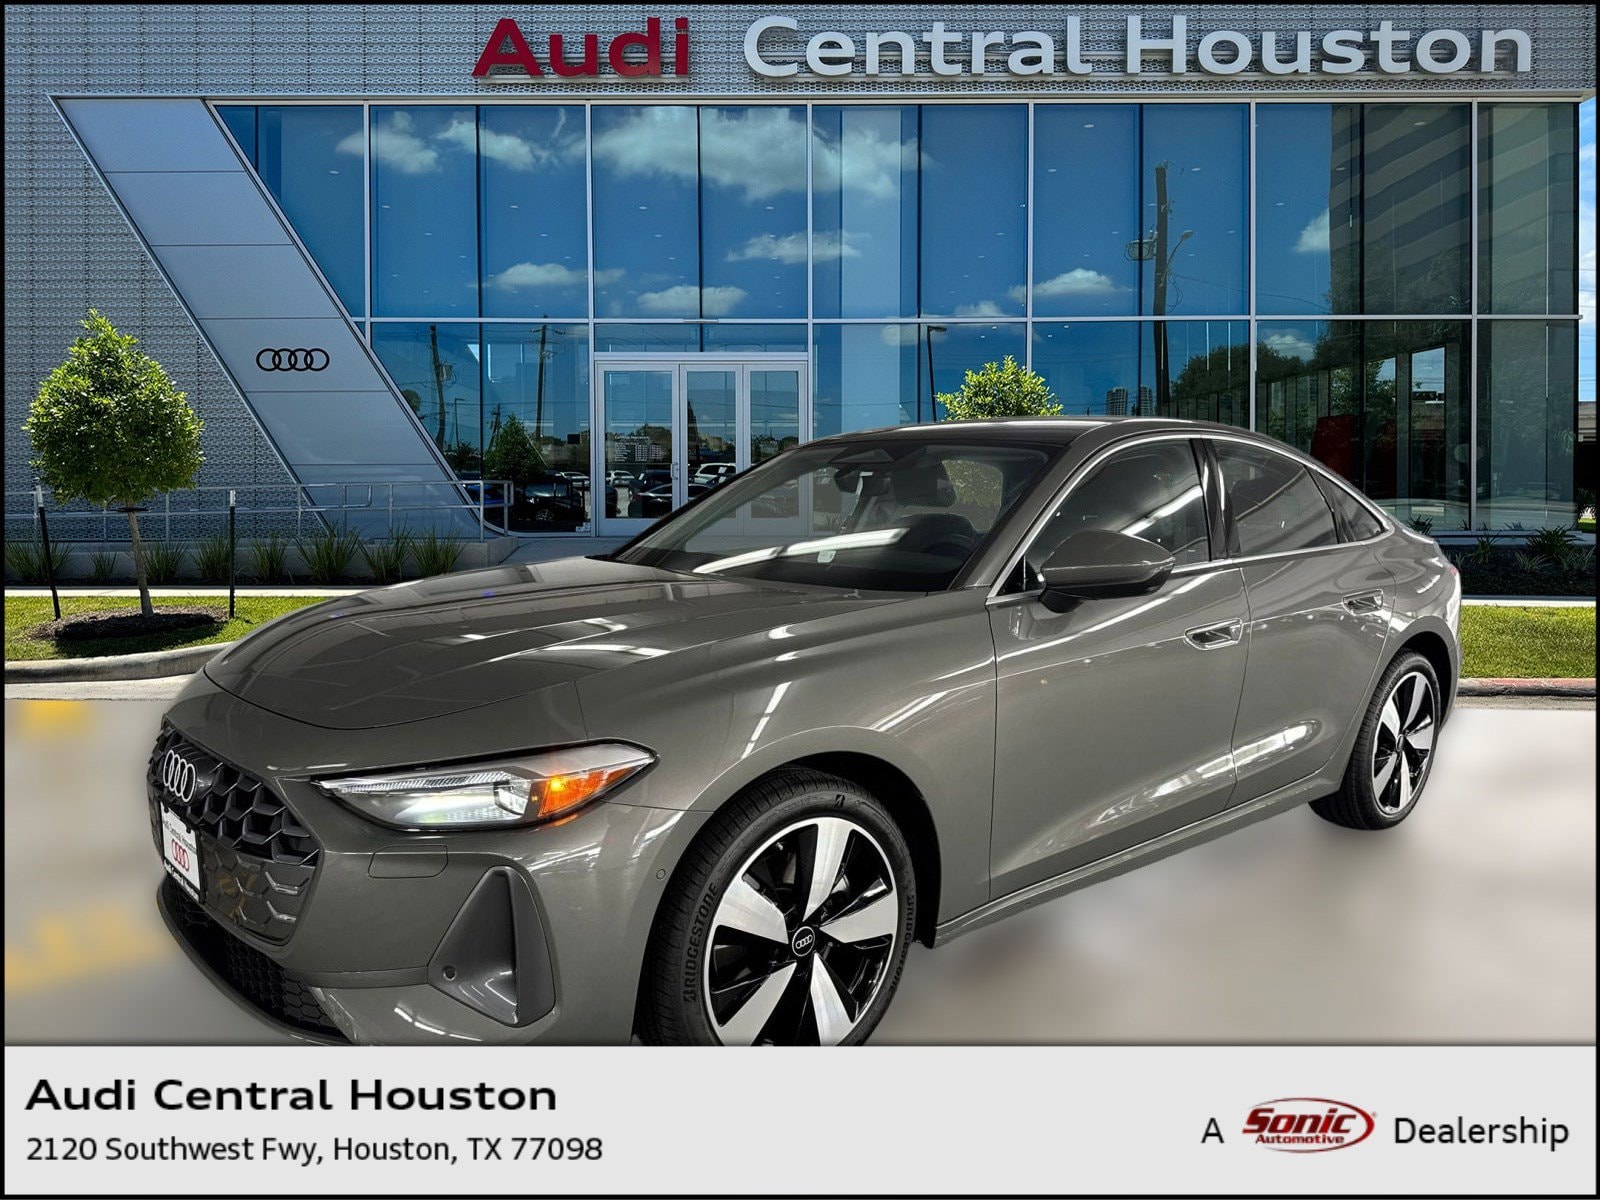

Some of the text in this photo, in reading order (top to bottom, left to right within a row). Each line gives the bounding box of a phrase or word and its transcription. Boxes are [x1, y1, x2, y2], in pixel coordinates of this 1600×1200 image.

[471, 15, 1533, 79] Audi Central Houston
[682, 882, 719, 1003] BRIDGESTONE
